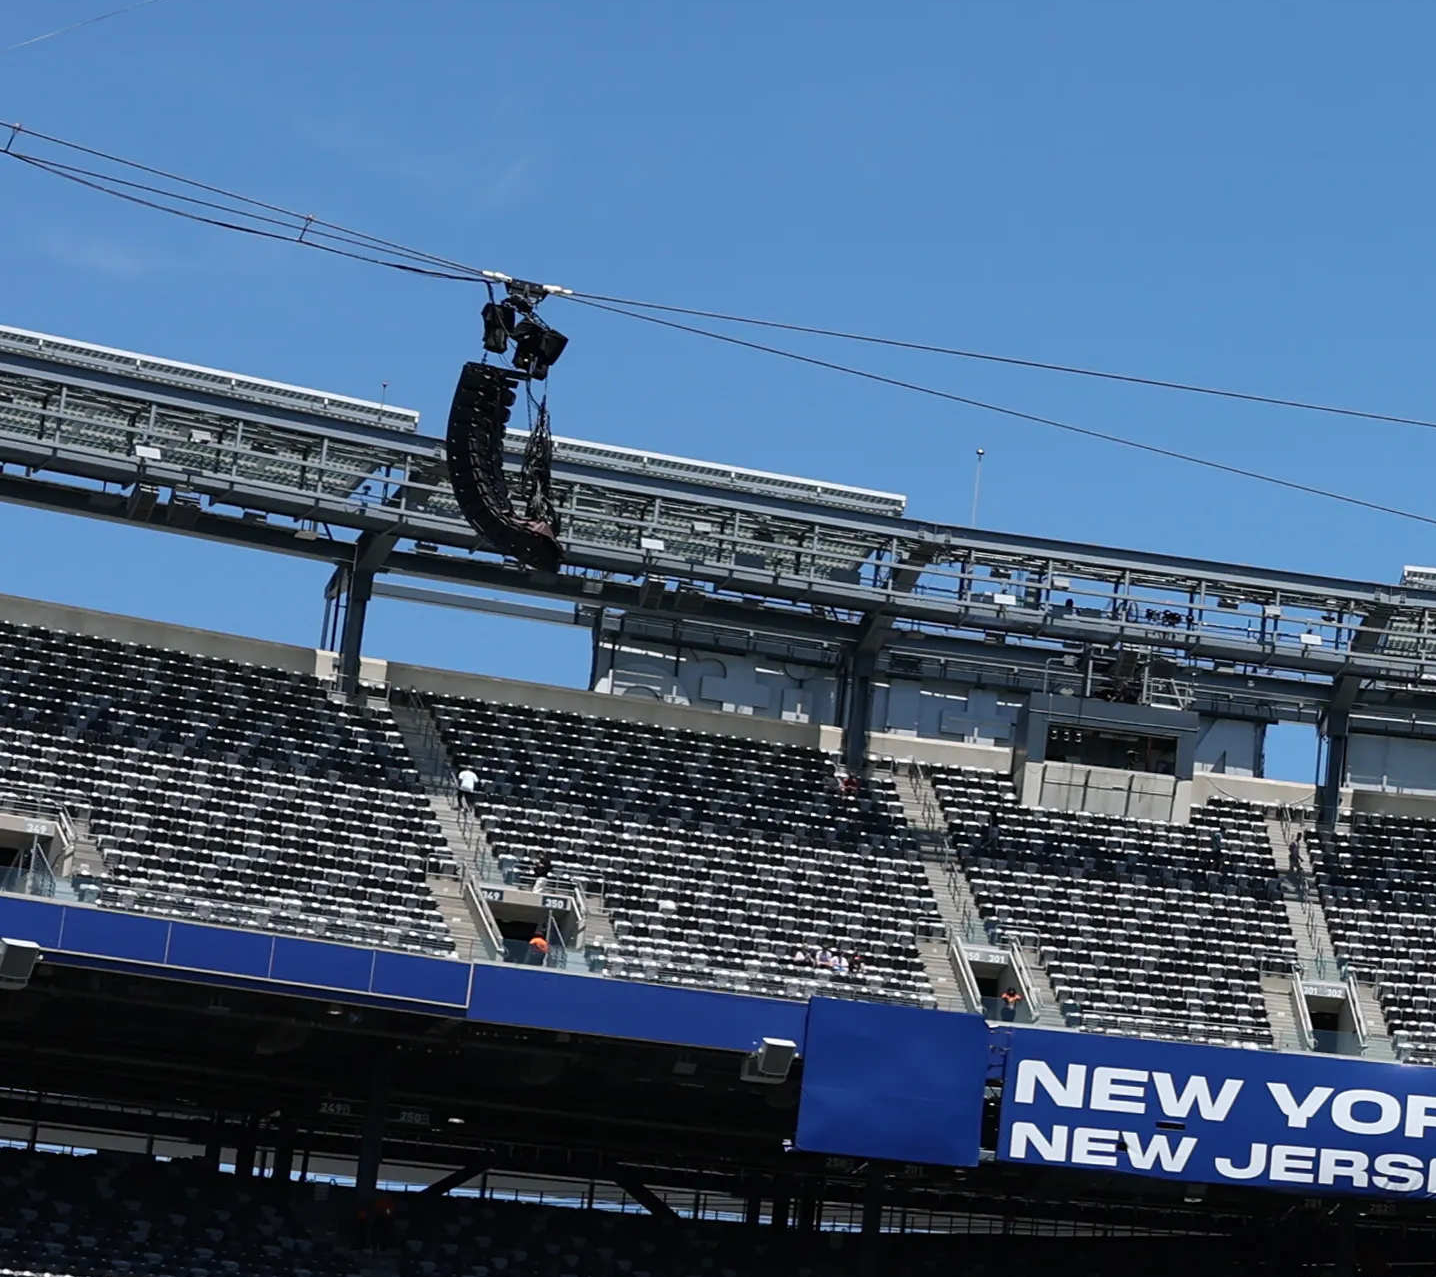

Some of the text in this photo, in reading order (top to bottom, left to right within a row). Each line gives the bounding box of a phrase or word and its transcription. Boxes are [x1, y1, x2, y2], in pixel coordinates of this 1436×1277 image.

[26, 822, 47, 834] 349
[545, 897, 564, 910] 350
[1014, 1059, 1244, 1123] NEW
[1010, 1121, 1198, 1173] NEW
